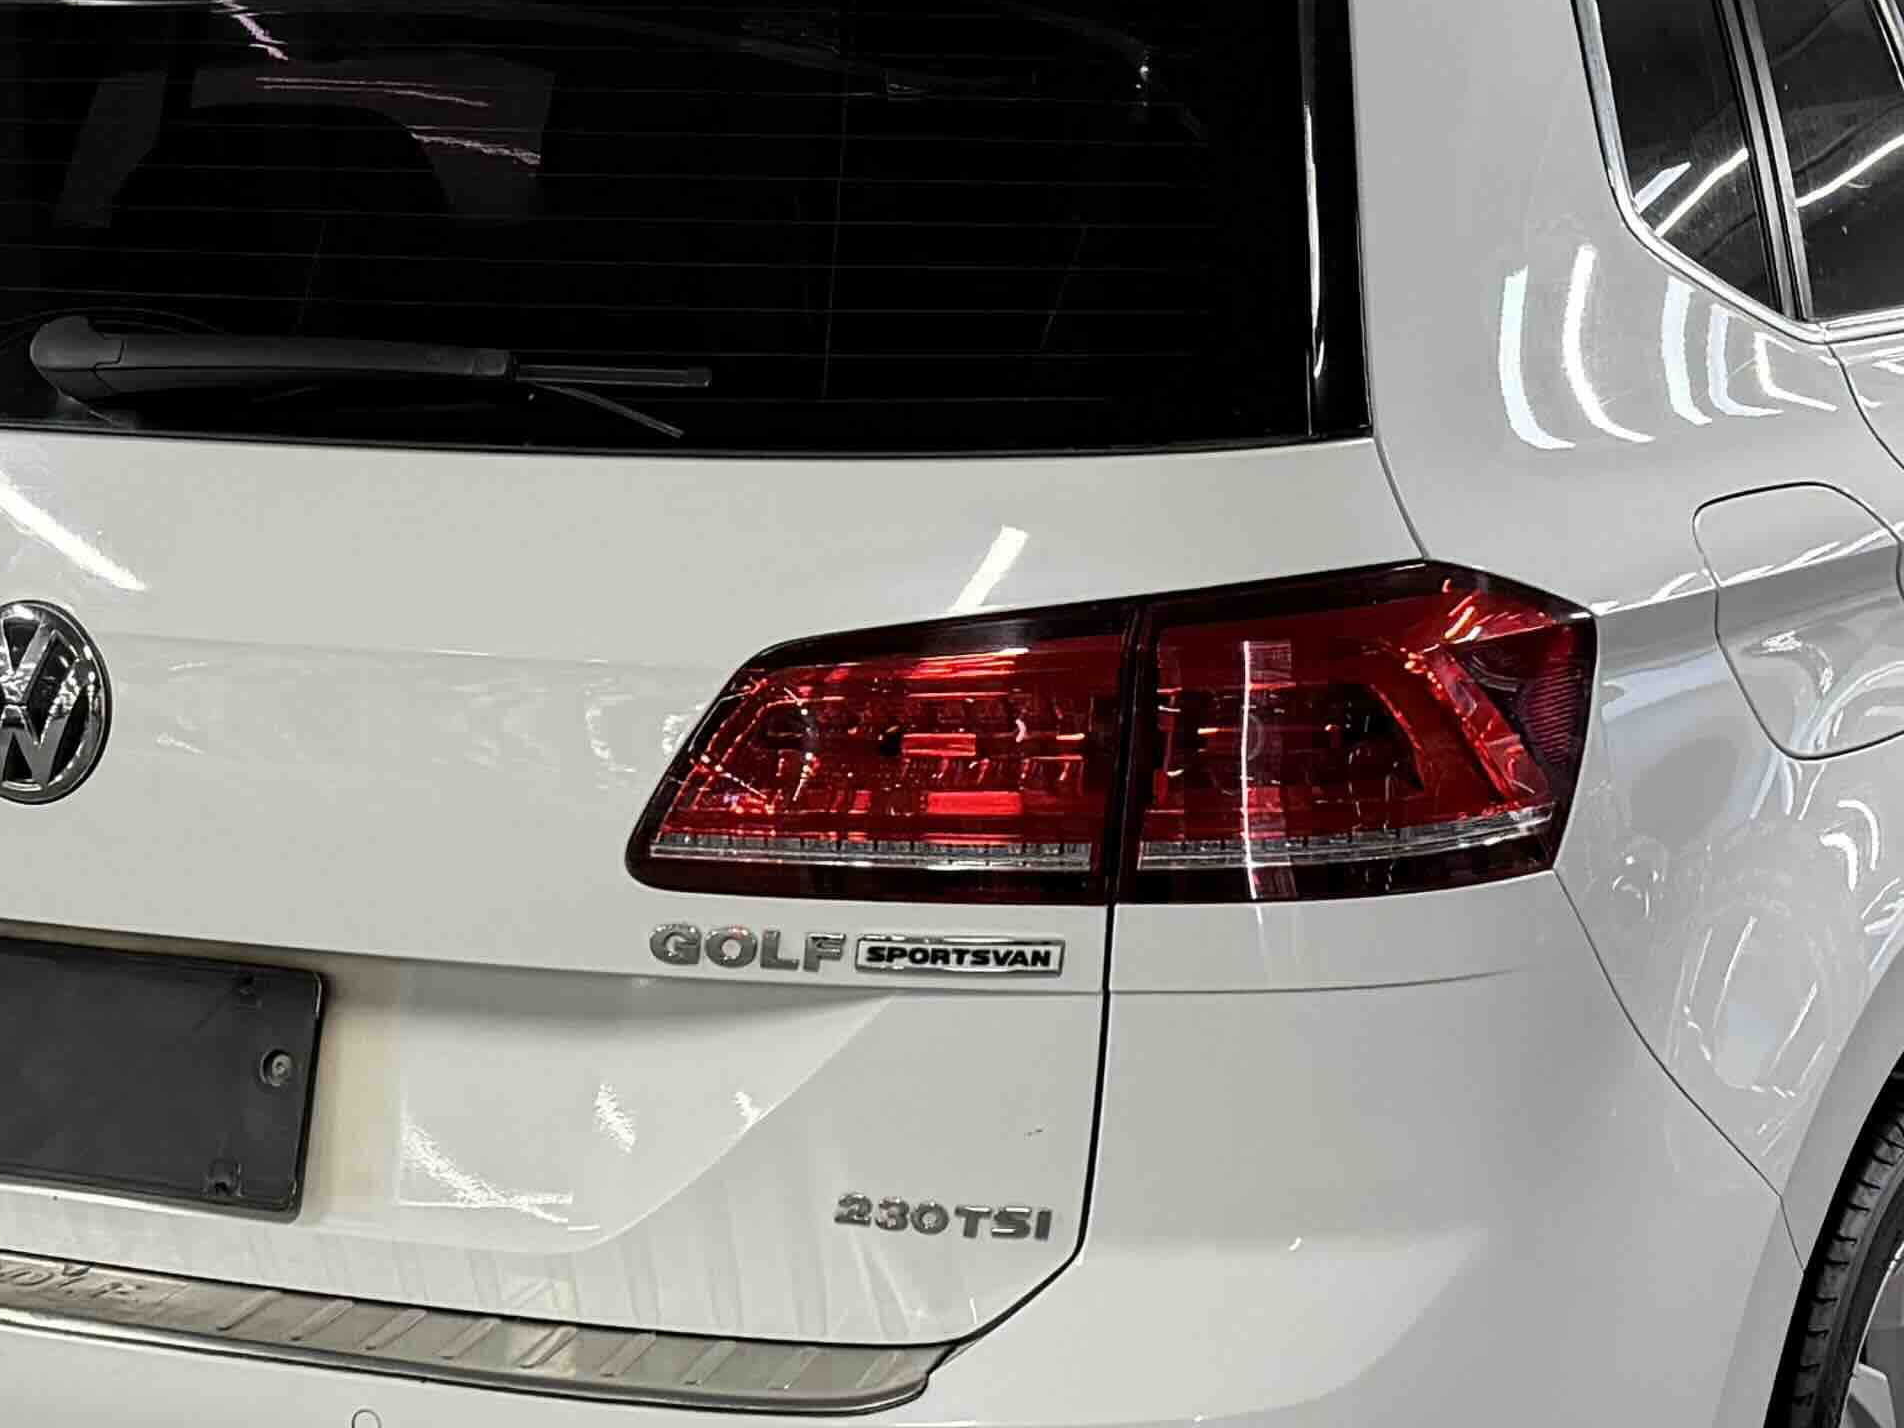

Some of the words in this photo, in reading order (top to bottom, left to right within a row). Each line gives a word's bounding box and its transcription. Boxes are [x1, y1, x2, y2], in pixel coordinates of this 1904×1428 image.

[649, 923, 847, 973] GOLF
[865, 944, 1051, 968] SPORTSVAN
[833, 1191, 1053, 1240] 230TSI
